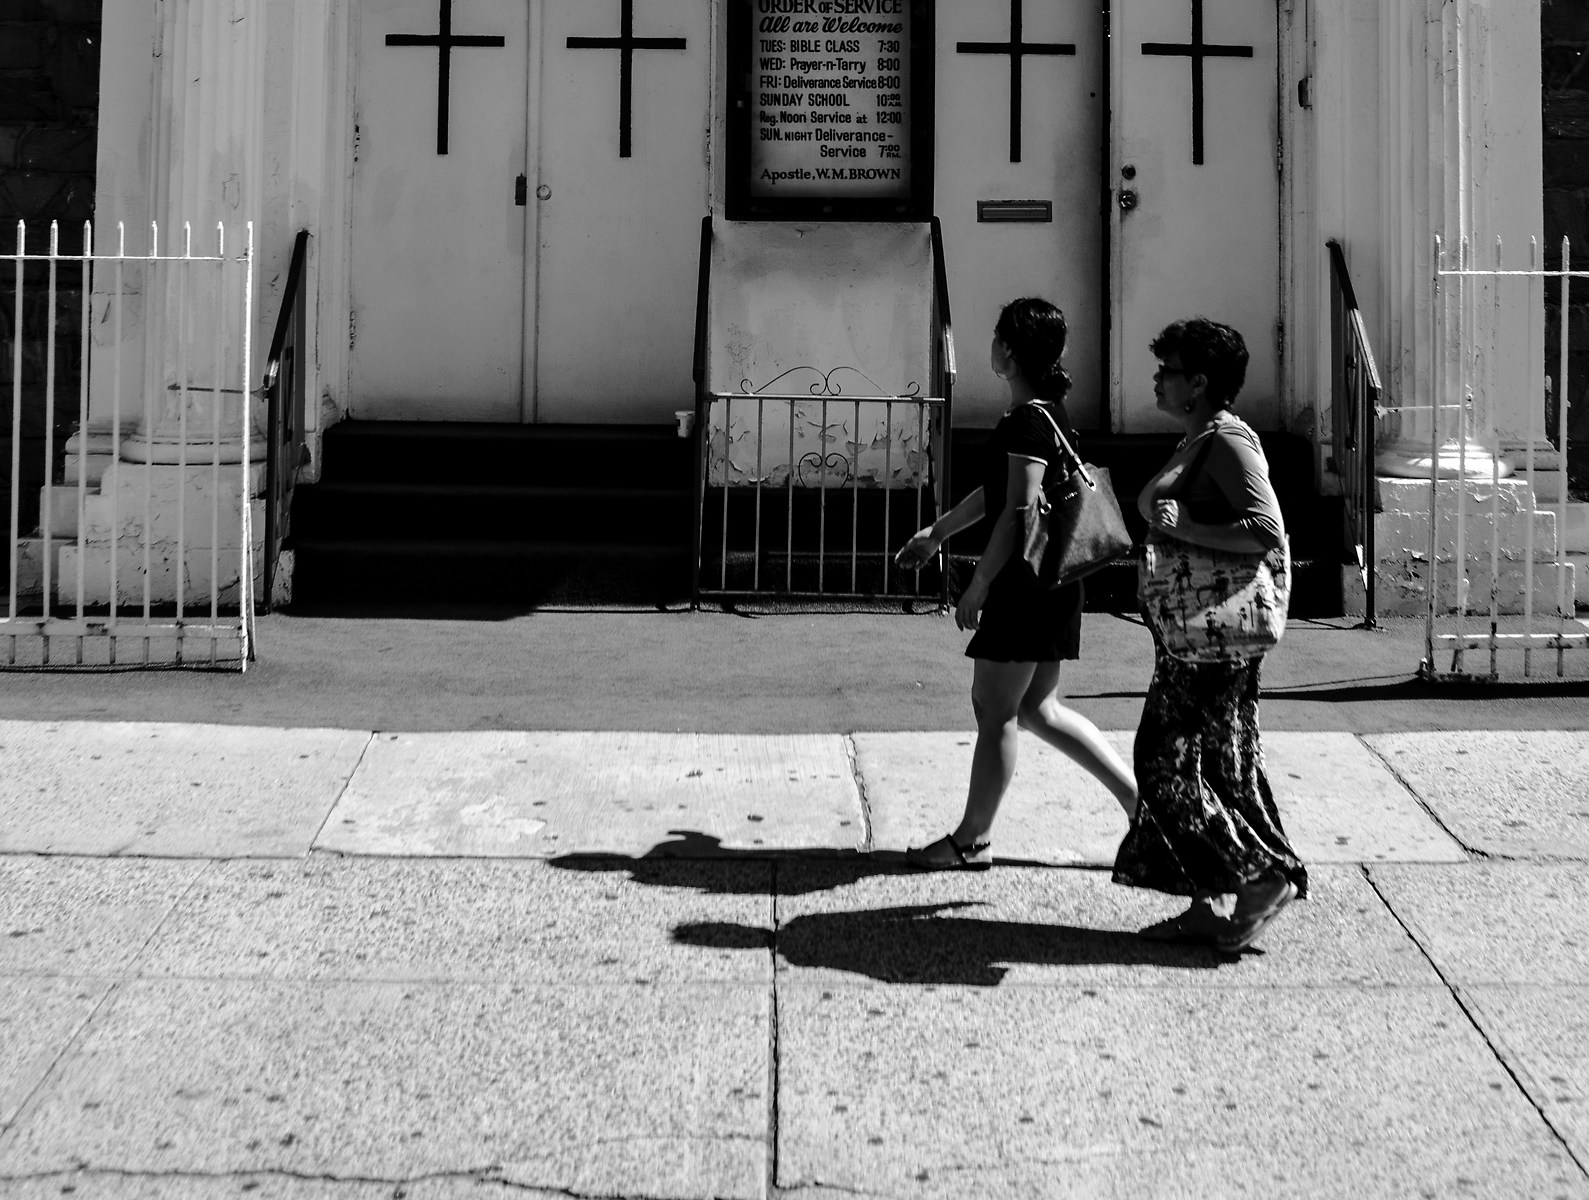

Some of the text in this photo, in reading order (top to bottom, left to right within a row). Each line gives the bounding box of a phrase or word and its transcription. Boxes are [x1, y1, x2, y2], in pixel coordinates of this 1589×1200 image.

[819, 2, 834, 13] OF
[759, 16, 903, 33] All are Welcome
[760, 40, 900, 53] TUES: BIBLE CLASS 7:30
[760, 57, 786, 71] WED:
[877, 58, 900, 71] 8:00
[760, 76, 900, 89] FRI: Deliverance Service 8:00
[760, 94, 803, 107] SUNDAY
[808, 94, 850, 107] SCHOOL
[760, 111, 901, 126] Reg. Noon Service at 12:00
[760, 128, 783, 141] SUN.
[784, 132, 813, 141] NIGHT
[820, 145, 867, 158] Service
[849, 168, 900, 180] BROWN
